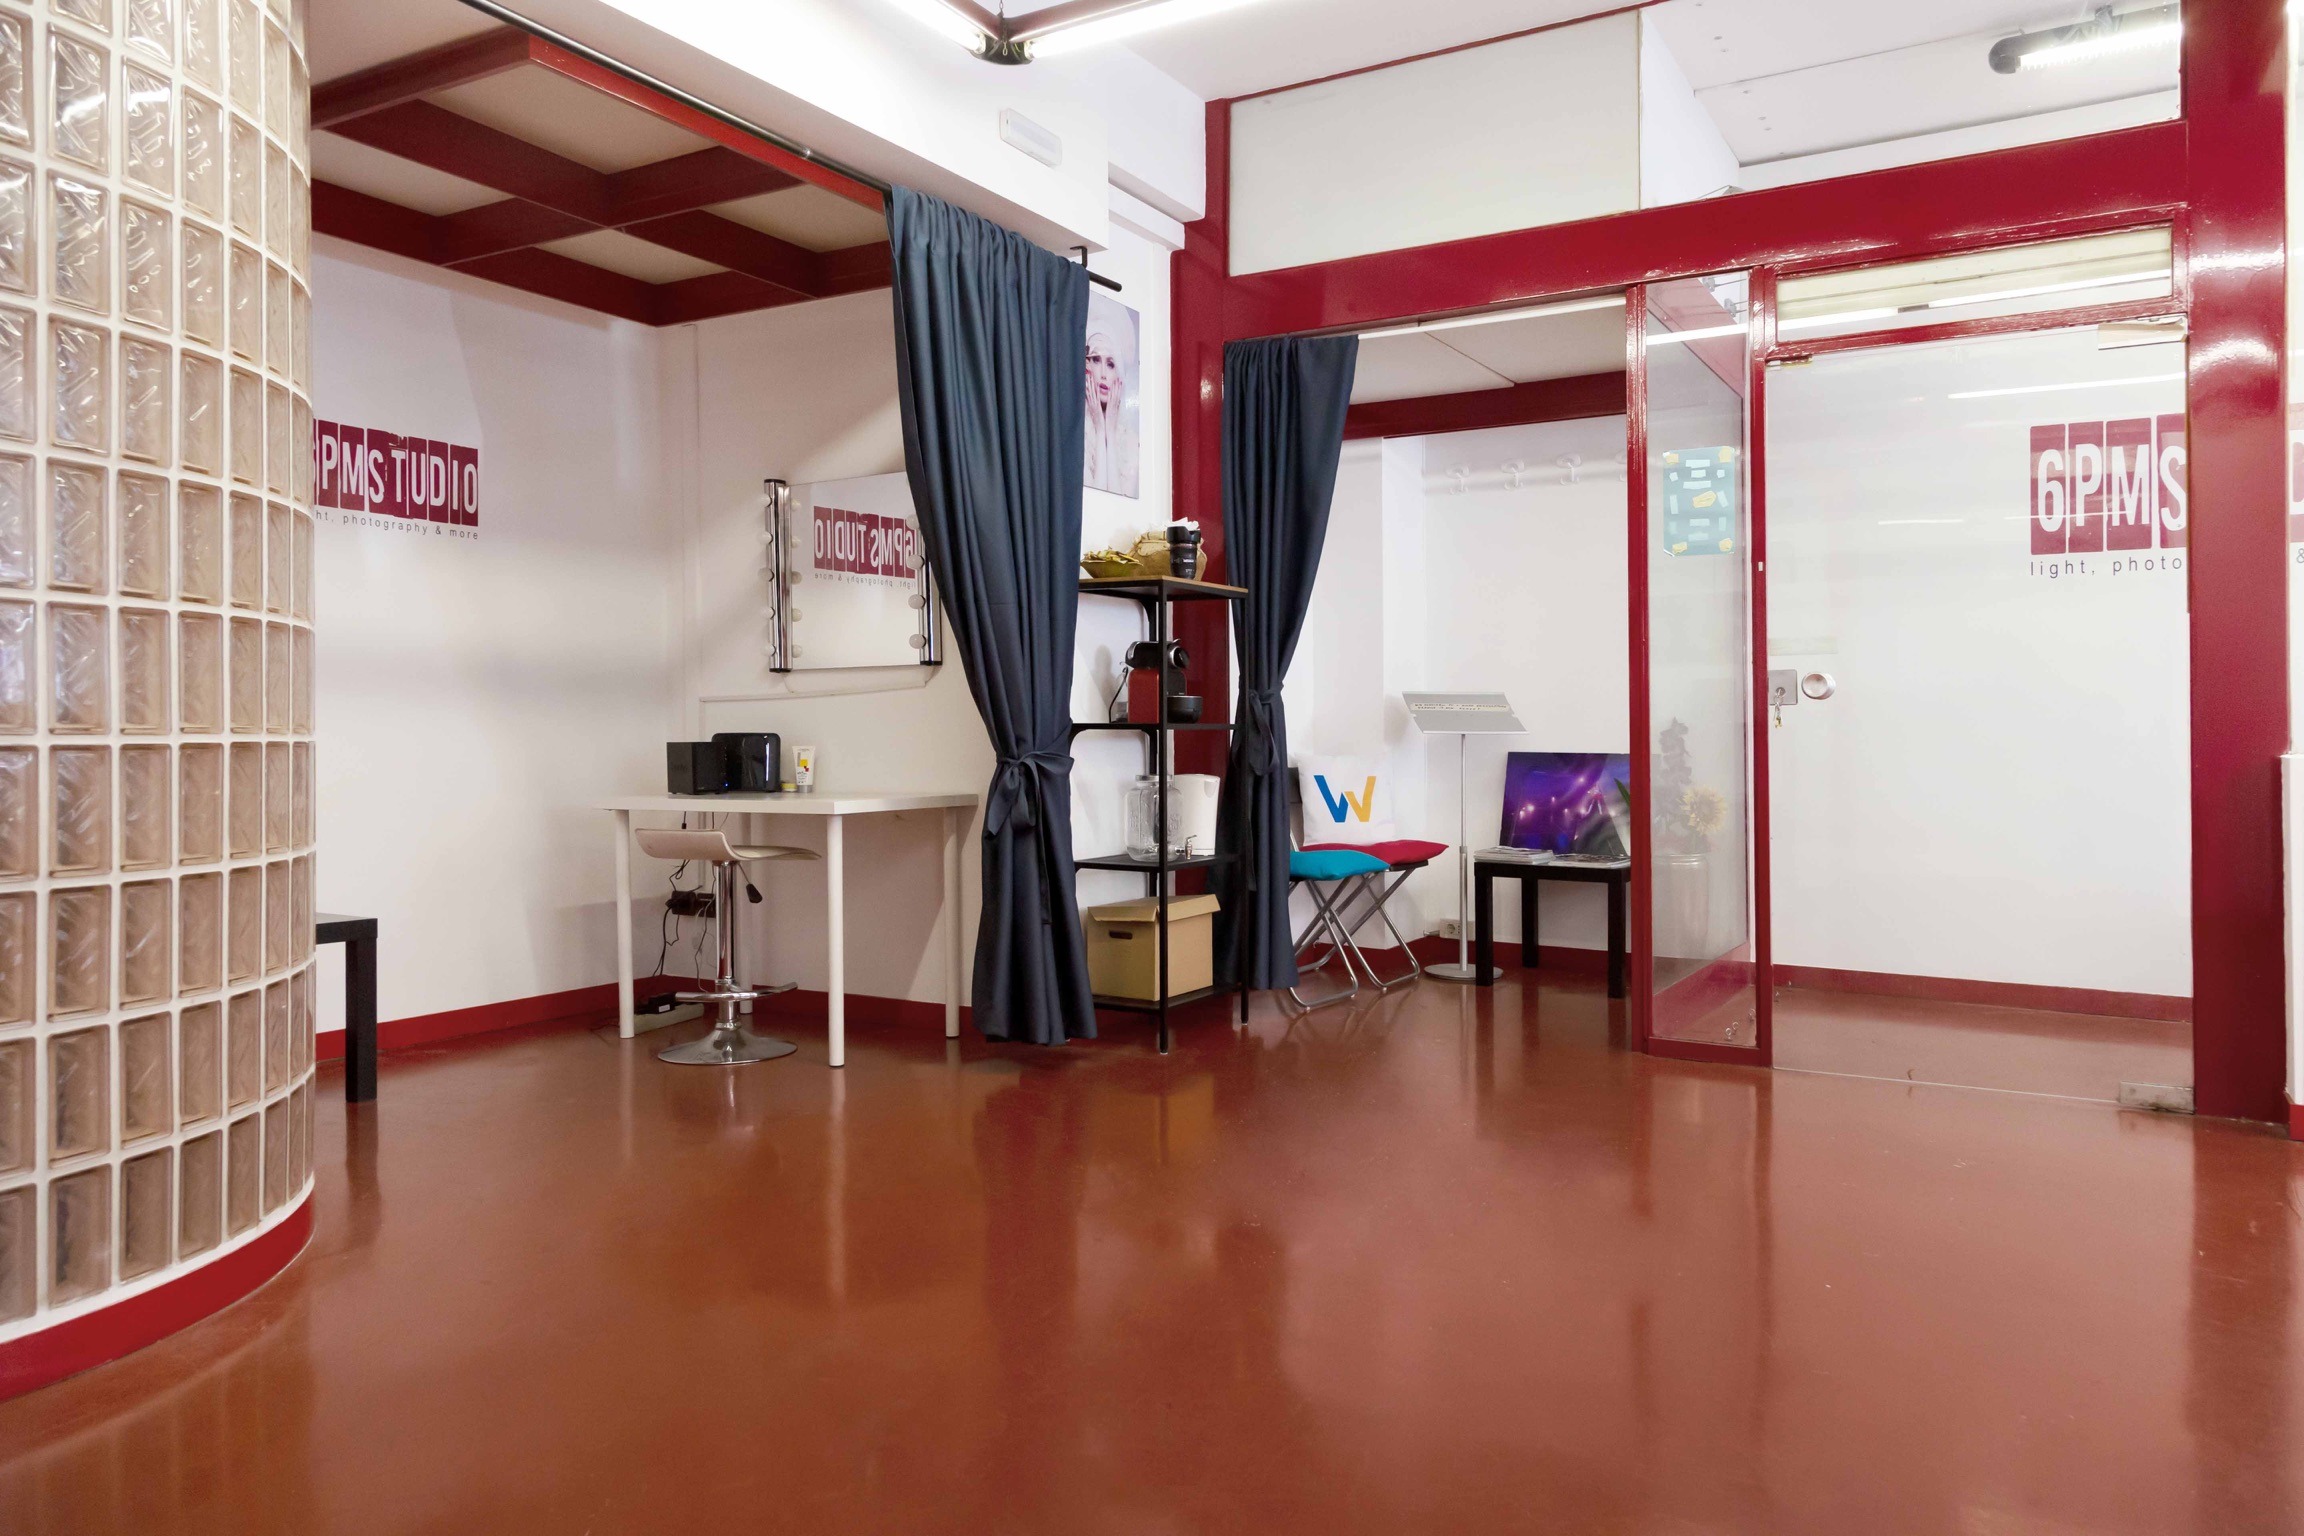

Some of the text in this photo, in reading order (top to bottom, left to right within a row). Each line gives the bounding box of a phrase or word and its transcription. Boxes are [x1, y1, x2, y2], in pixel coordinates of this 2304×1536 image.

[314, 433, 478, 515] PMSTUDIO
[2036, 442, 2187, 533] 6PMS
[343, 514, 428, 536] photography
[435, 525, 442, 535] &
[449, 528, 478, 540] more
[2030, 555, 2183, 579] light, photo
